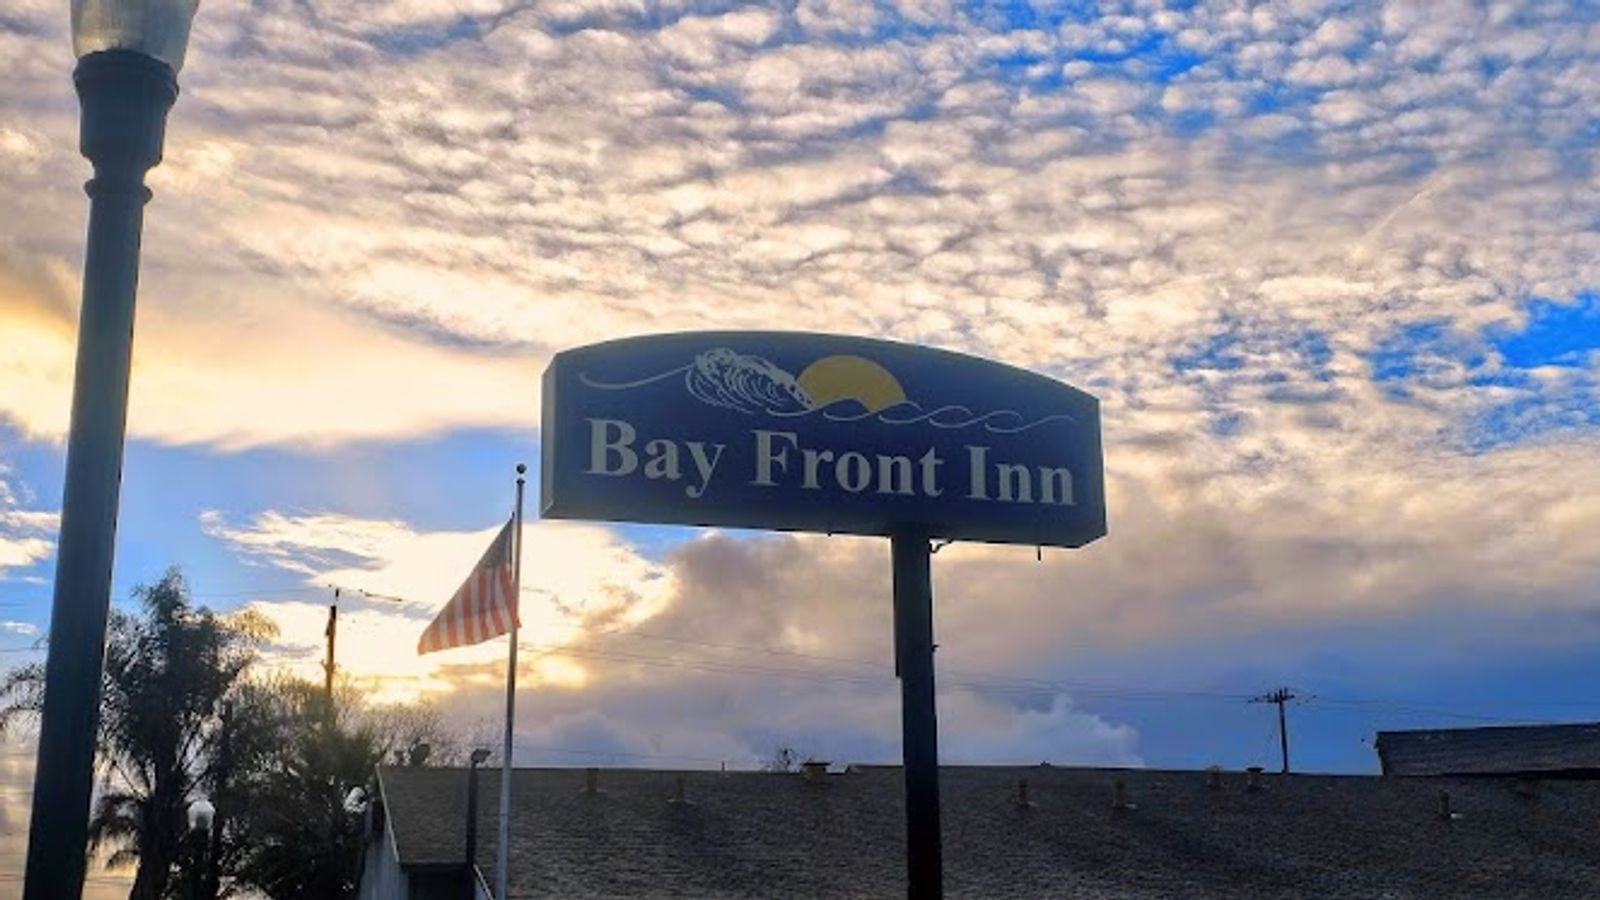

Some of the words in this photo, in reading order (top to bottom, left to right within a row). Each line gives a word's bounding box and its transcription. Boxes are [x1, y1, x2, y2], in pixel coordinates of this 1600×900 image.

[584, 417, 727, 499] Bay
[752, 430, 943, 497] Front
[966, 445, 1076, 506] Inn
